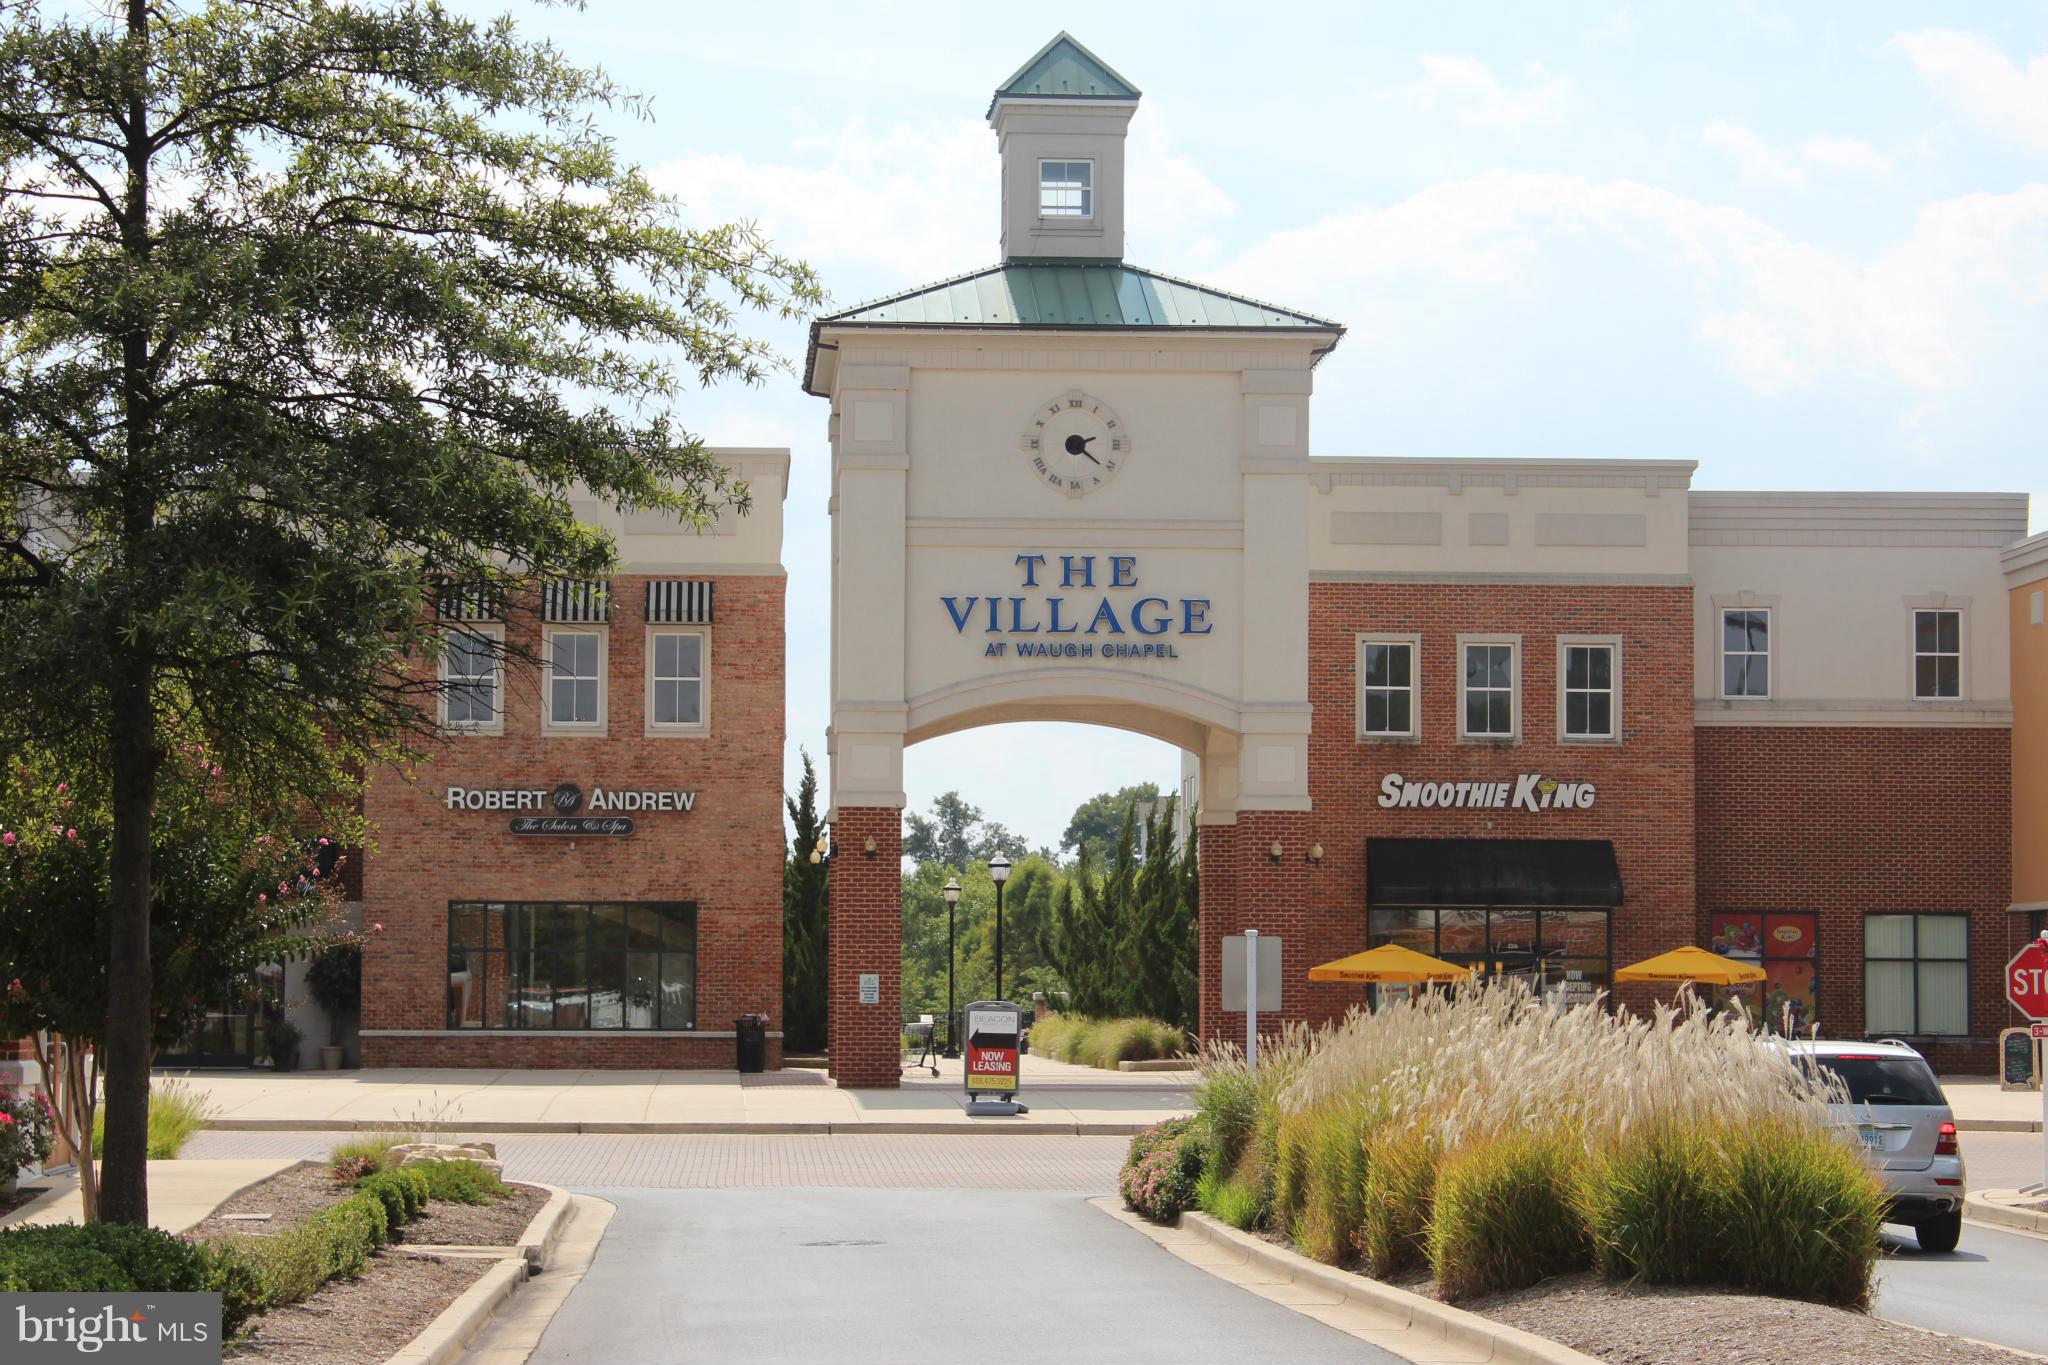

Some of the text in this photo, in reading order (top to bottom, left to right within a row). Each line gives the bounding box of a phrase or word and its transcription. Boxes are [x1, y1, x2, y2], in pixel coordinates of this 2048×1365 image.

[1014, 553, 1139, 588] THE
[940, 596, 1213, 635] VILLAGE
[984, 642, 1179, 658] AT WAUGH CHAPEL
[446, 787, 548, 811] ROBERT
[588, 788, 696, 811] ANDREW
[1377, 773, 1511, 809] SMOOTHIE
[515, 817, 540, 832] The
[541, 817, 578, 832] Salon
[601, 818, 628, 835] Spa
[974, 1015, 1015, 1024] BEACON
[981, 1051, 1004, 1061] NOW
[973, 1061, 1012, 1072] LEASING
